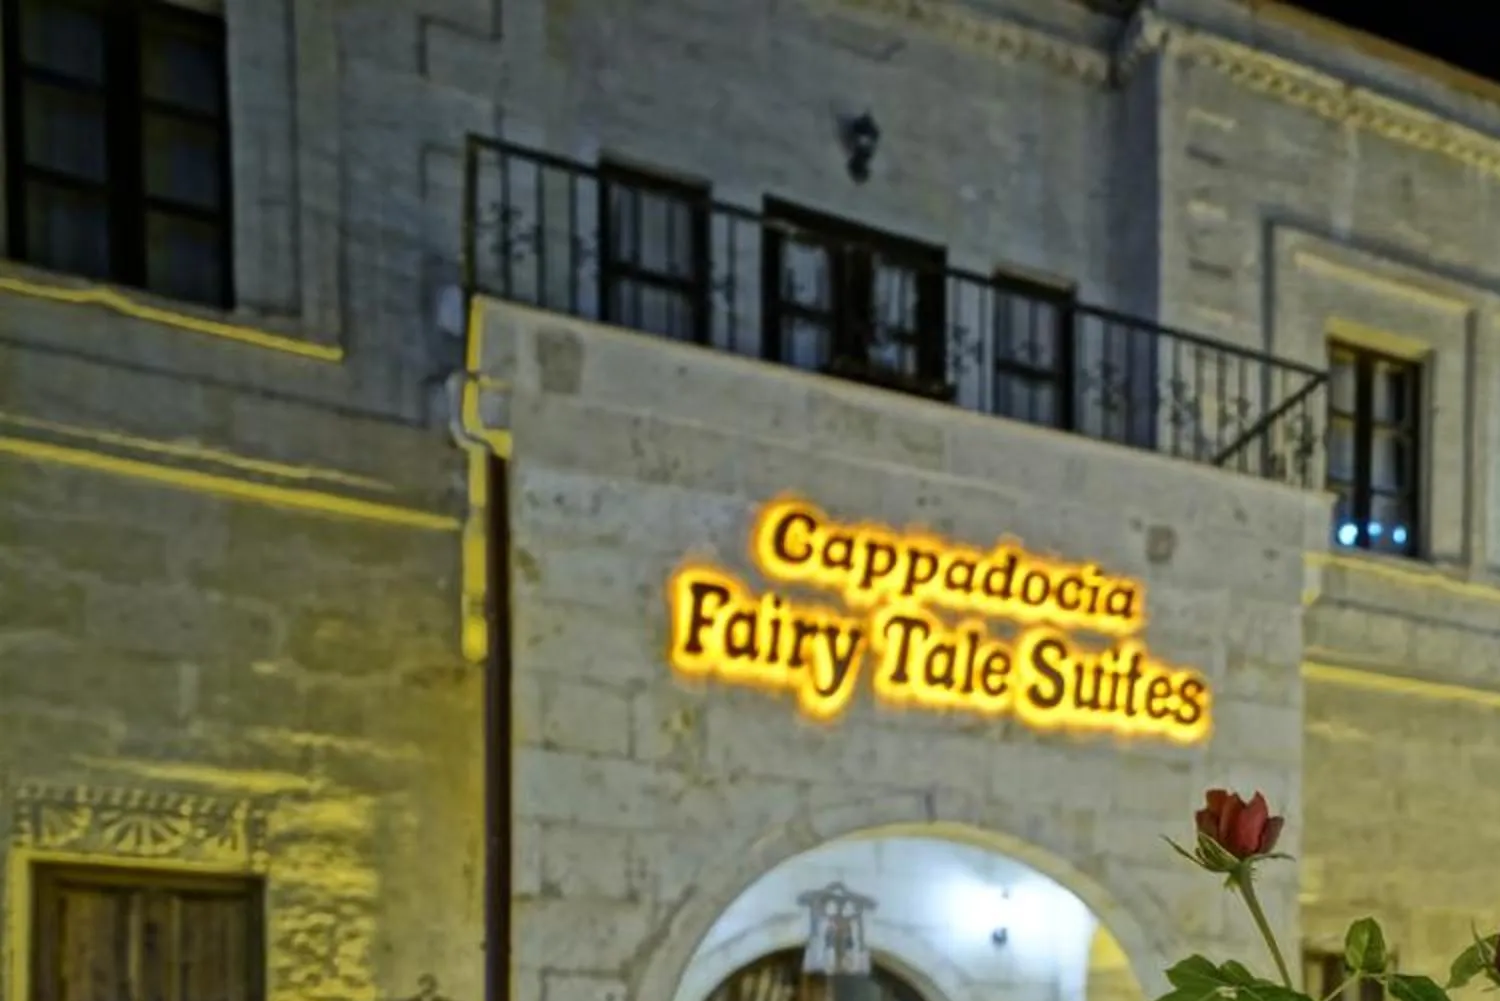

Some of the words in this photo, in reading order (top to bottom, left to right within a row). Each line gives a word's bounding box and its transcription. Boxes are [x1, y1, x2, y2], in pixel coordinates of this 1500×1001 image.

[773, 511, 1136, 619] Cappadocia
[684, 582, 861, 697] Fairy
[884, 616, 1011, 696] Tale
[1028, 638, 1205, 725] Suites
